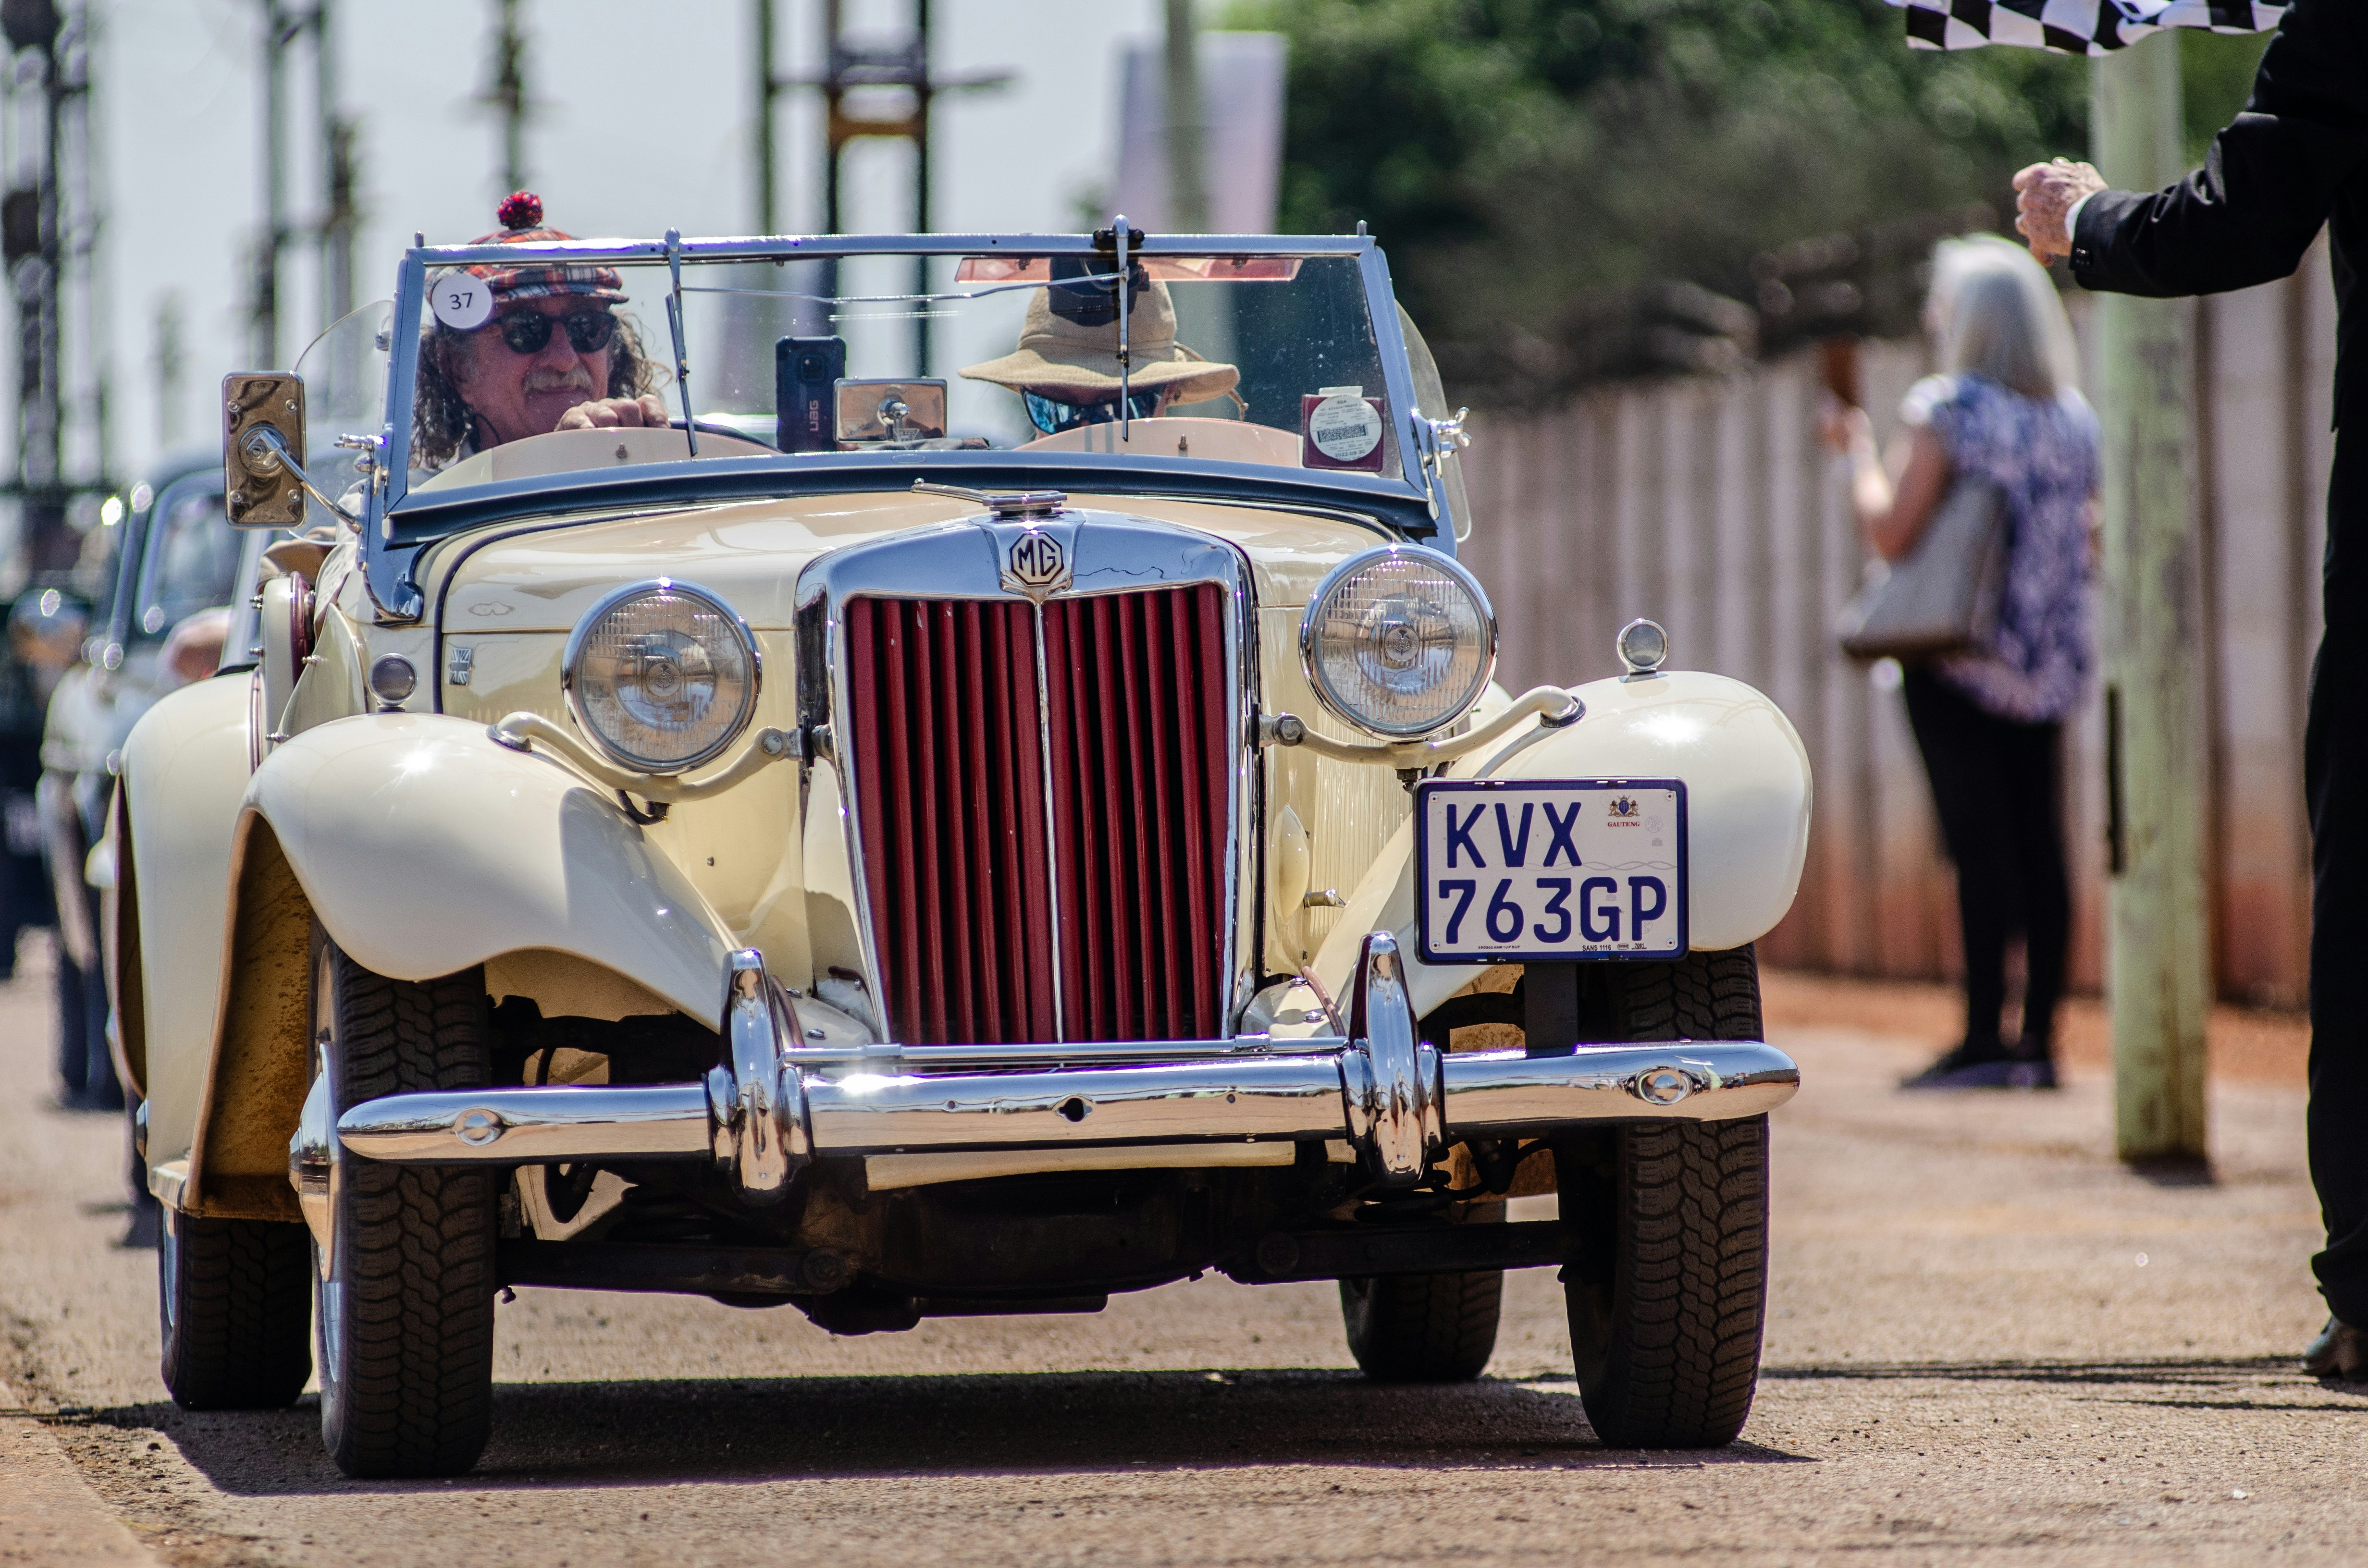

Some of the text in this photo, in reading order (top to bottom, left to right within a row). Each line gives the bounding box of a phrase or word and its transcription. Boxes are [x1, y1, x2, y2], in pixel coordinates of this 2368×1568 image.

[449, 292, 472, 310] 37
[1017, 539, 1056, 577] MG
[1388, 640, 1418, 649] LUCAS
[1446, 802, 1583, 869] KVX
[1439, 876, 1667, 944] 763GP
